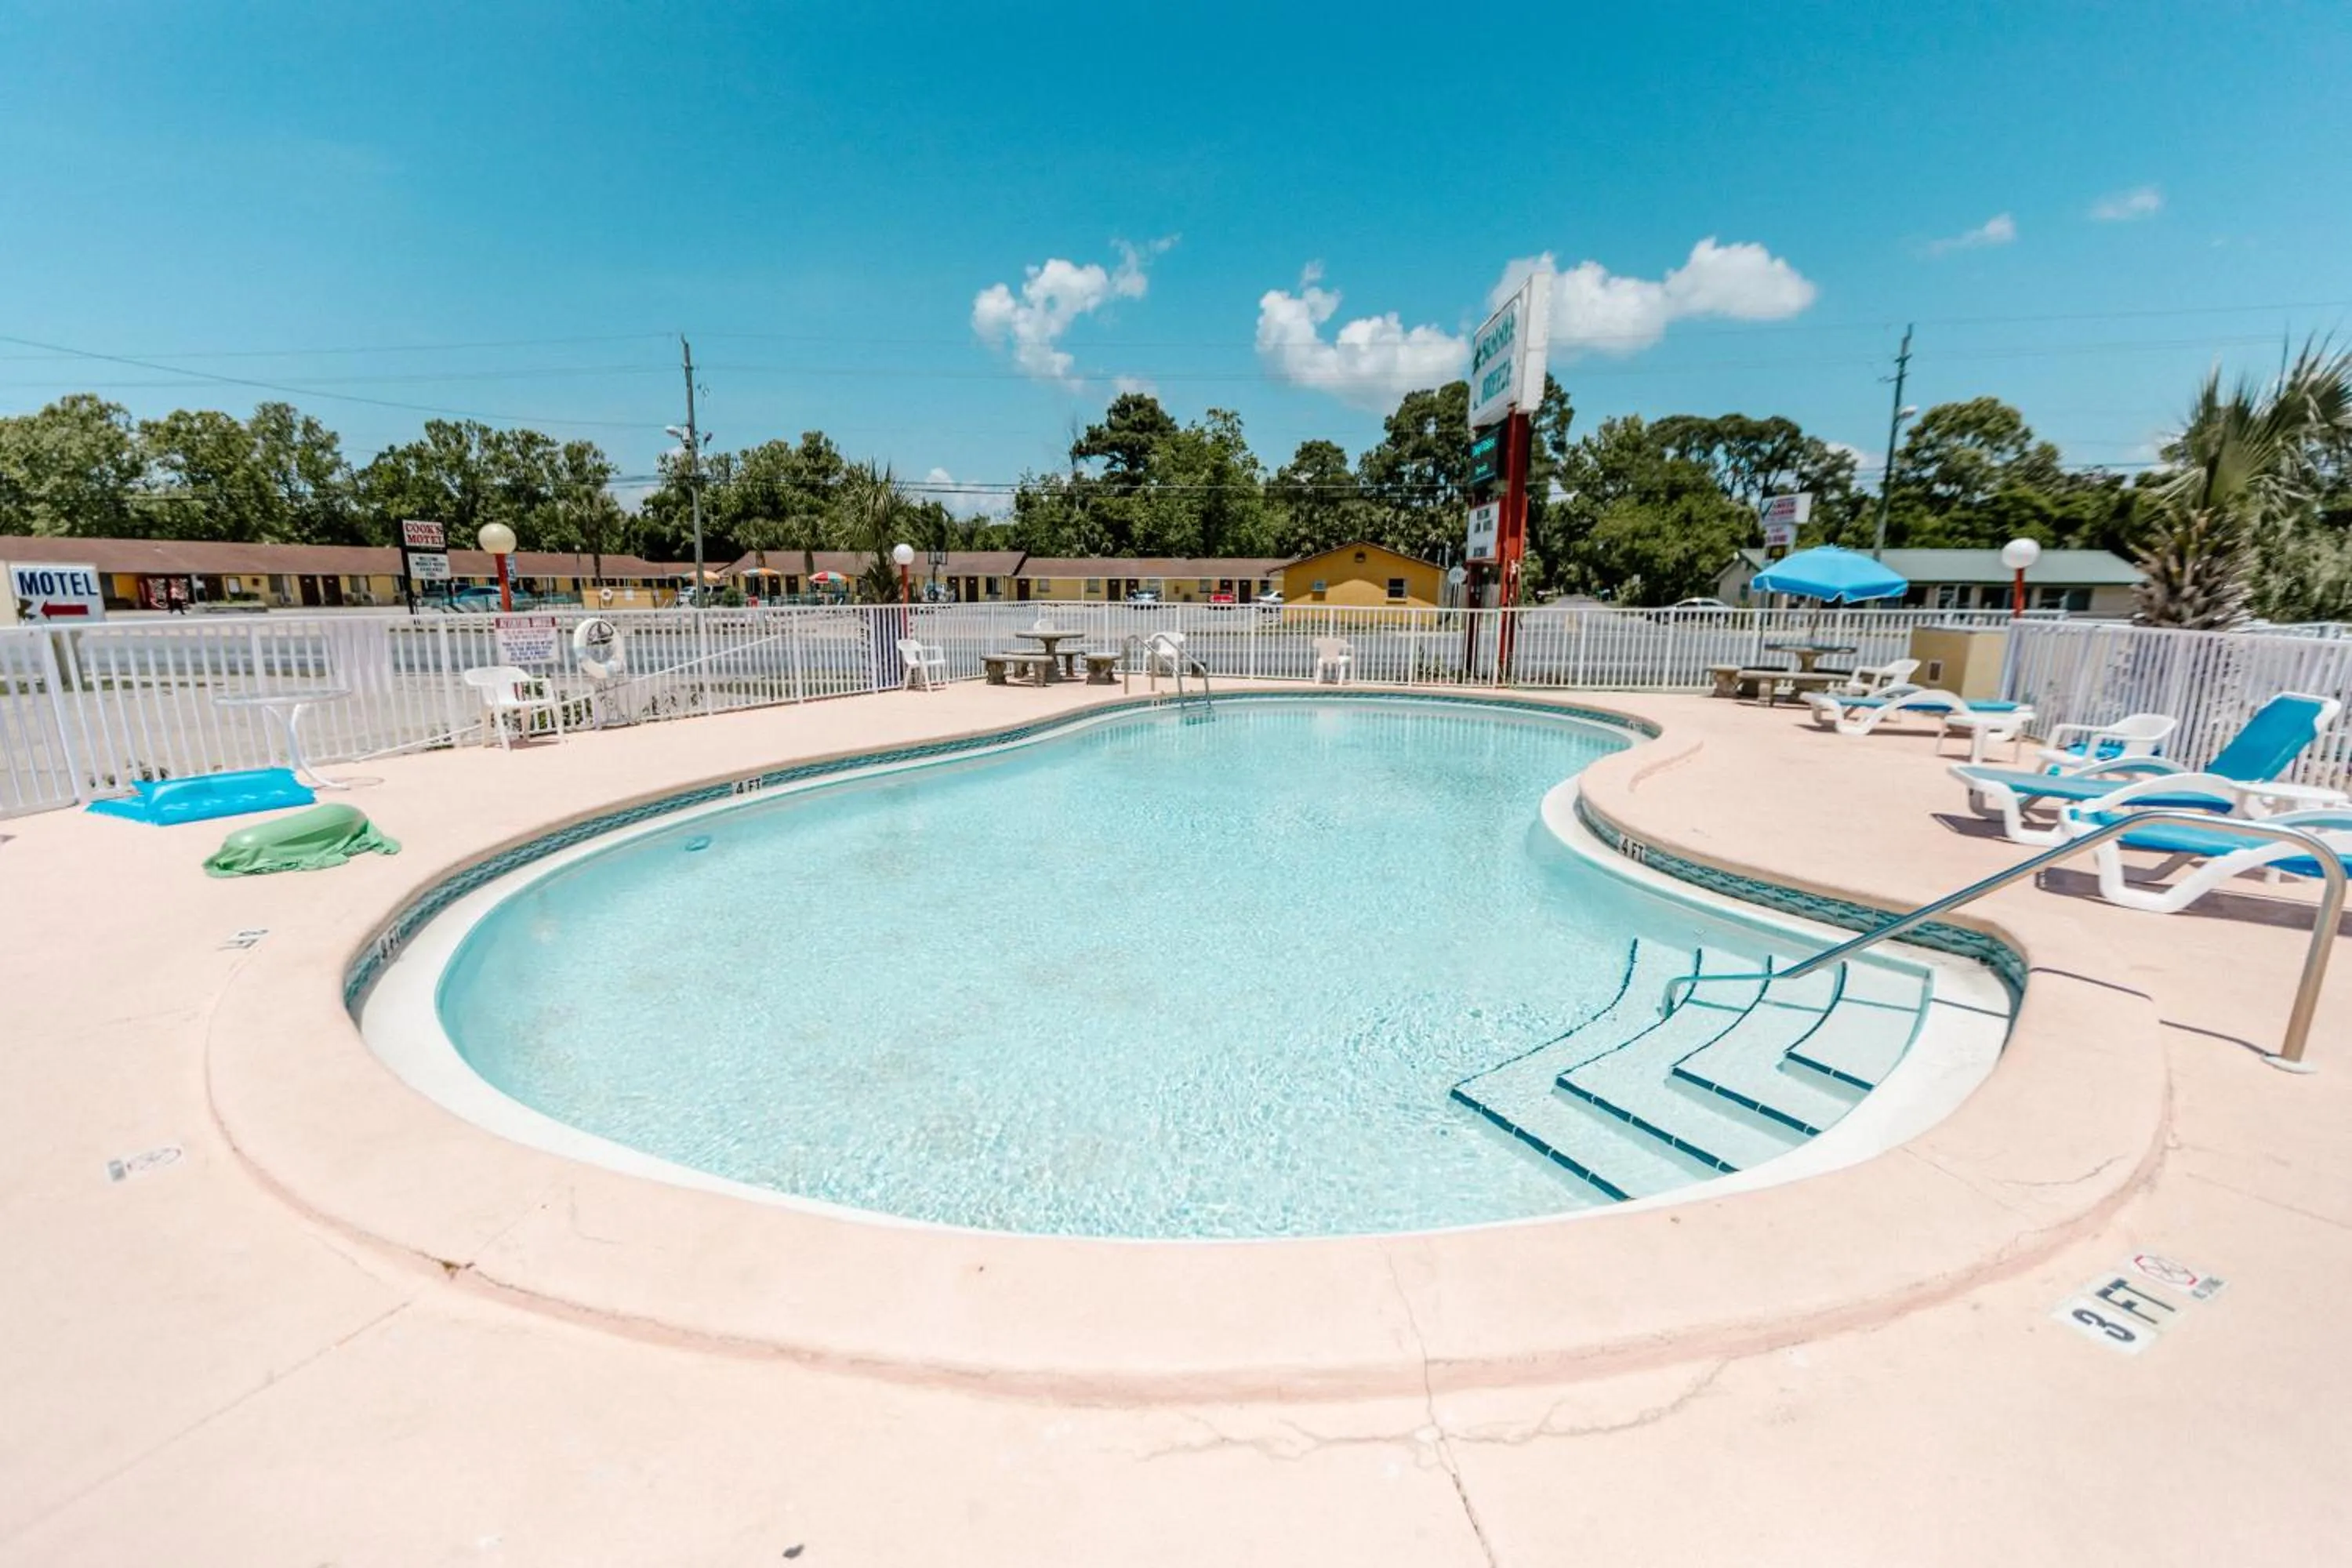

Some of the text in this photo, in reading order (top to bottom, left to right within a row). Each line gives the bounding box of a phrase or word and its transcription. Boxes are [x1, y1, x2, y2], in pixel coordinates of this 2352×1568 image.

[405, 523, 444, 535] COOK'S
[407, 534, 445, 545] MOTEL
[17, 572, 99, 596] MOTEL
[736, 778, 760, 794] 4 FT
[2095, 1277, 2176, 1325] FT
[2072, 1308, 2136, 1342] 3
